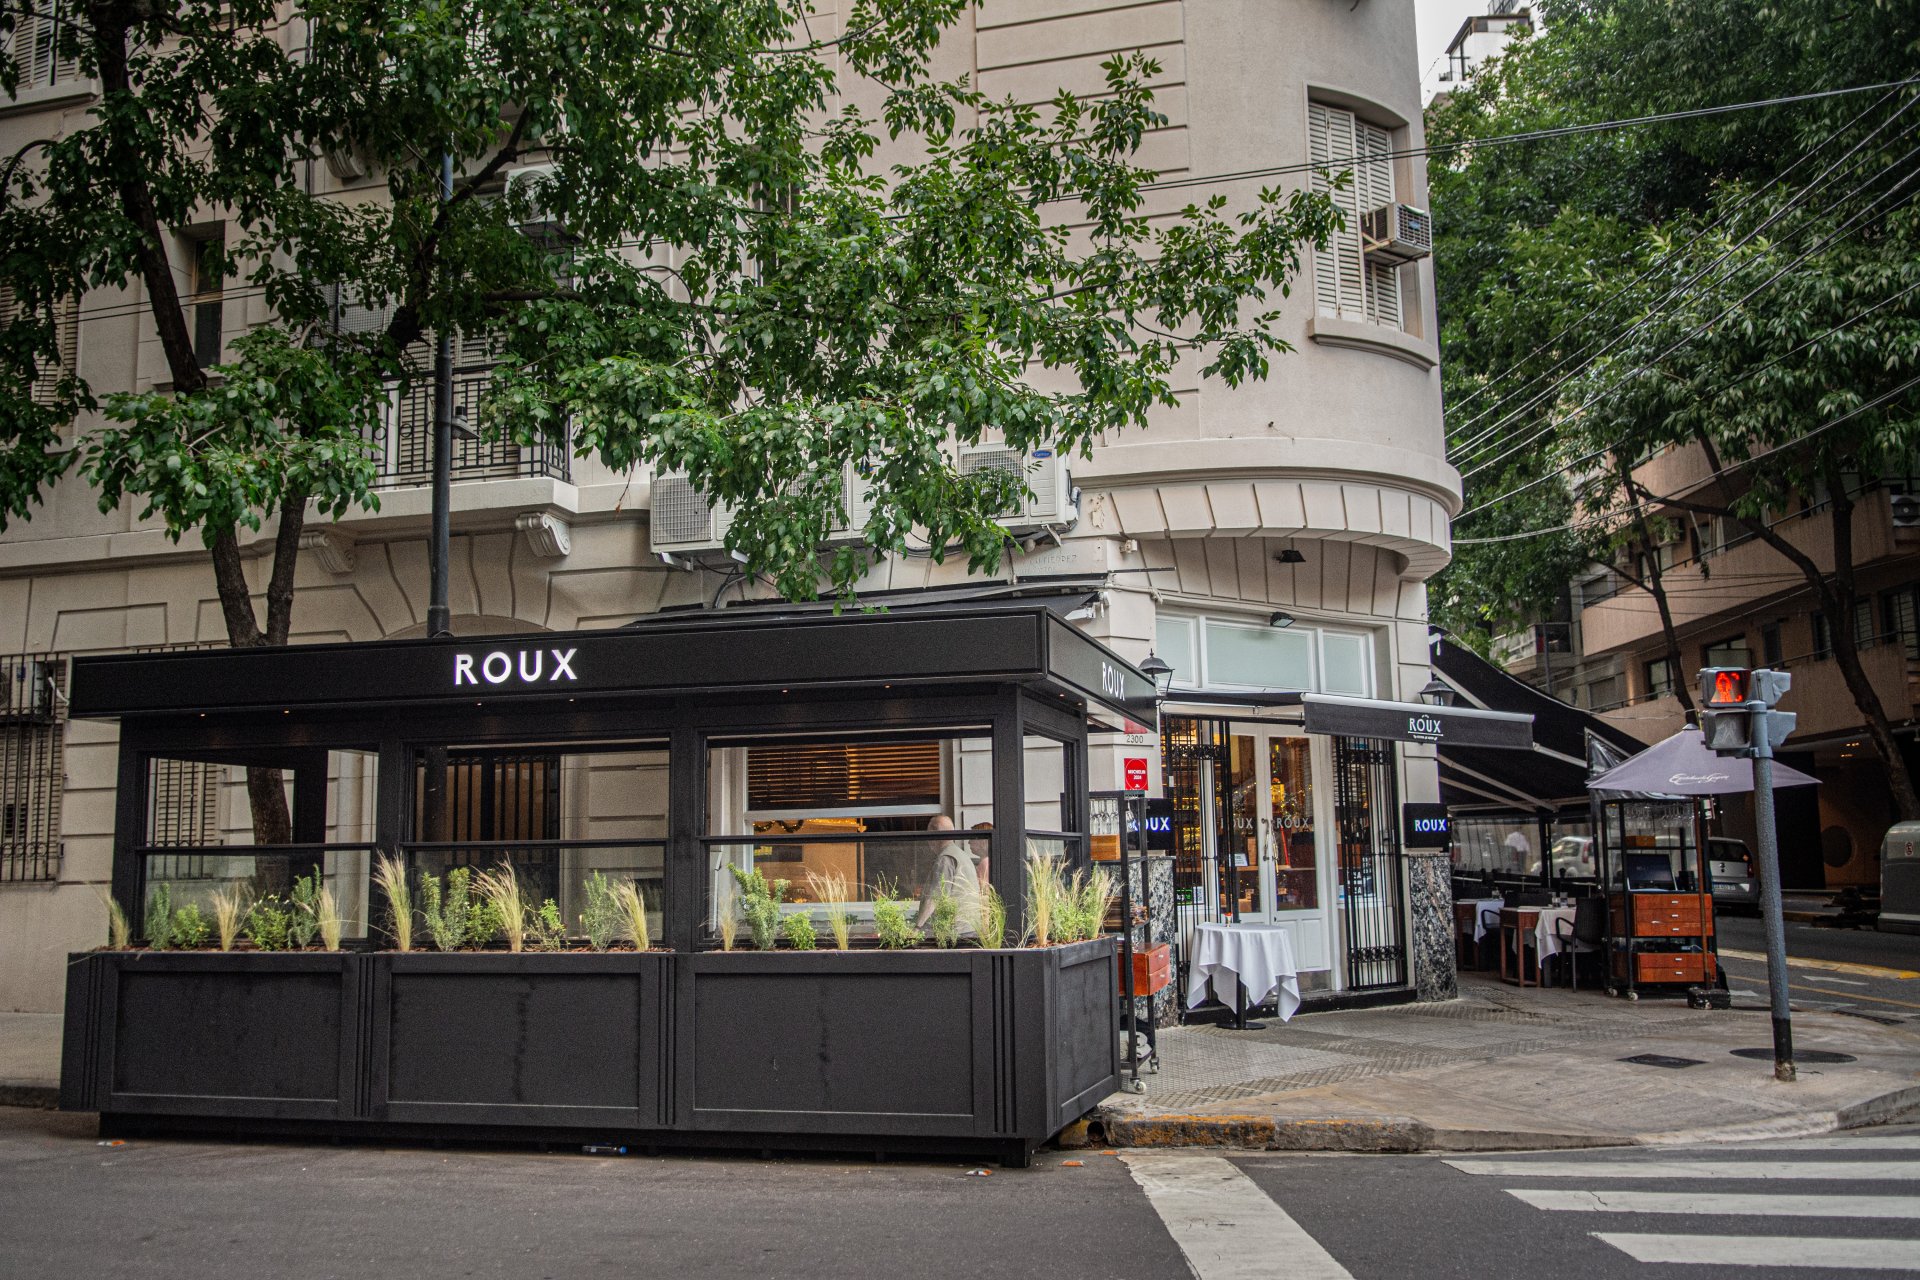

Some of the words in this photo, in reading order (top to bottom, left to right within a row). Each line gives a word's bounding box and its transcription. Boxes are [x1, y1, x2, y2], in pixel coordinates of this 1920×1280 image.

[455, 648, 578, 685] ROUX
[1102, 661, 1126, 701] ROUX
[1409, 717, 1441, 733] ROUX
[1126, 735, 1144, 744] 2300
[1277, 817, 1309, 829] ROUX
[1414, 819, 1447, 831] ROUX
